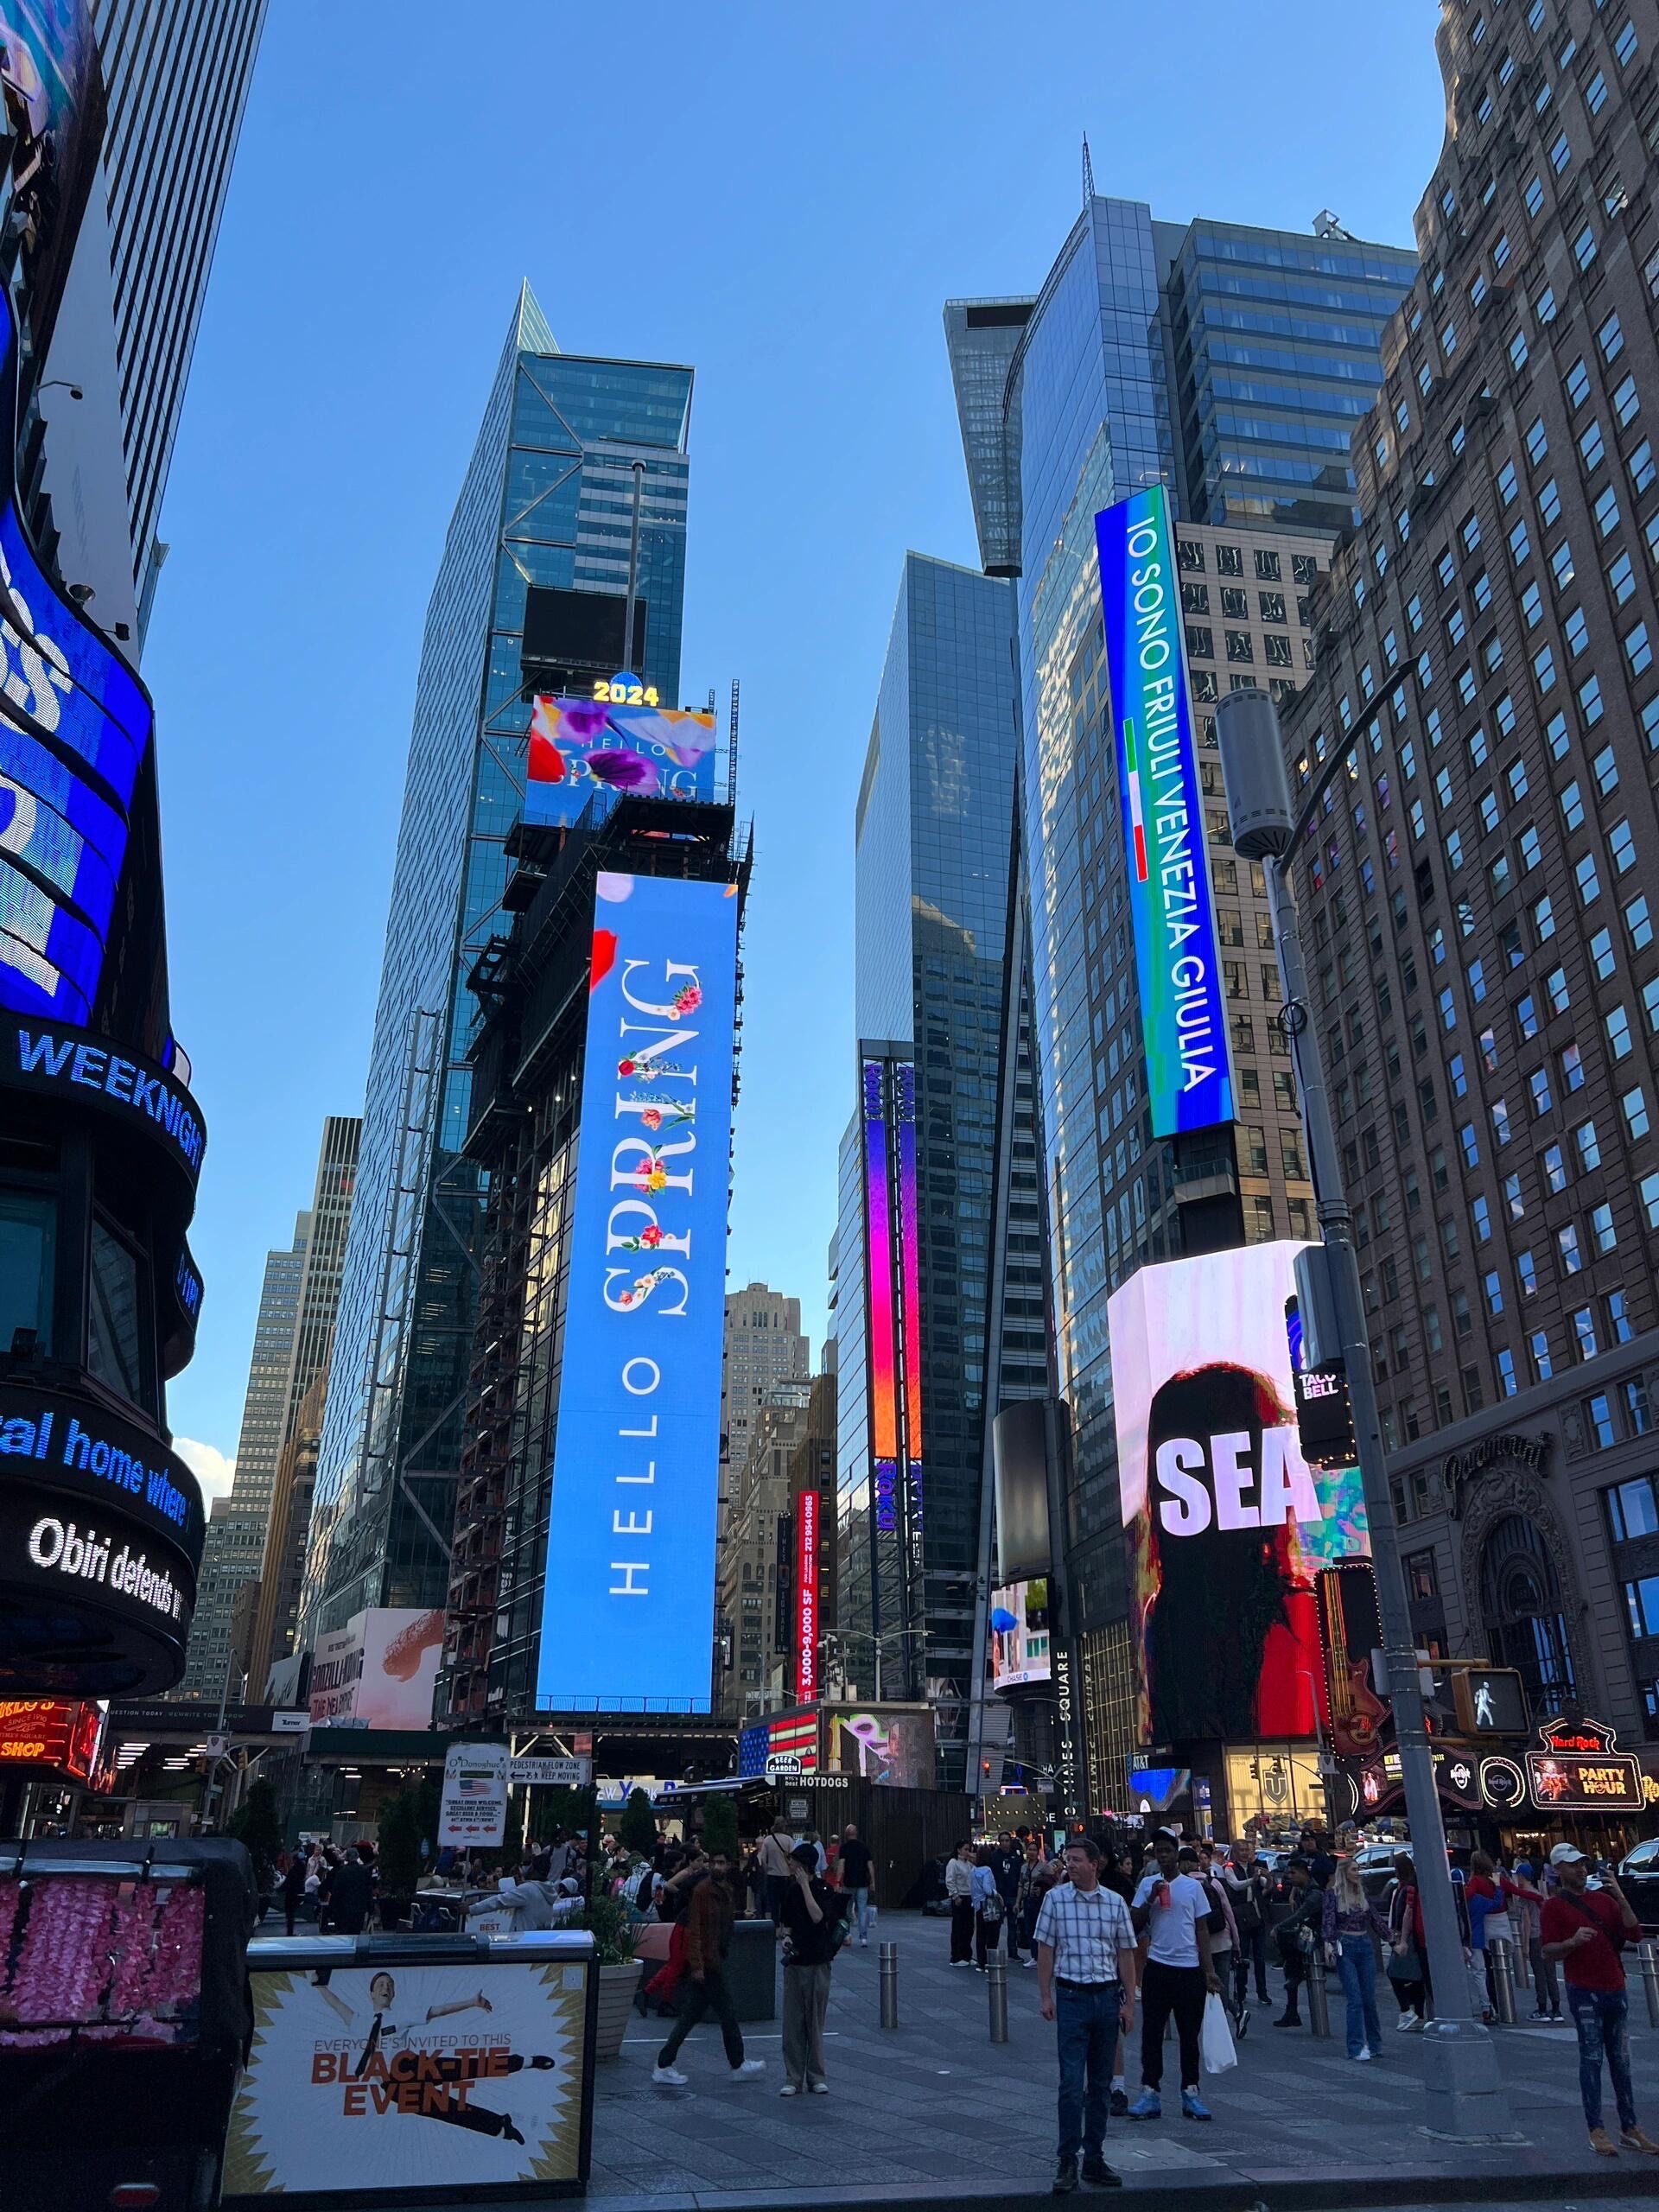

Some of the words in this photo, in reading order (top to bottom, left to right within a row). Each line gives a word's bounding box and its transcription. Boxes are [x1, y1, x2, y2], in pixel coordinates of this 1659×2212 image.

[1127, 517, 1158, 558] IO
[1131, 563, 1170, 671] SONO
[594, 681, 658, 706] 2024
[1143, 676, 1182, 780] FRIULI
[1154, 781, 1200, 950] VENEZIA
[1172, 956, 1217, 1092] GIULIA
[603, 958, 702, 1317] SPRING
[1303, 1382, 1339, 1400] BELL
[0, 1413, 54, 1459] al
[64, 1419, 143, 1493] home
[608, 1357, 660, 1595] HELLO
[1155, 1426, 1322, 1537] SEA
[29, 1518, 111, 1582] Obiri
[111, 1546, 173, 1613] defends
[803, 1589, 812, 1605] SF
[802, 1607, 813, 1686] 3,000-9,000
[1057, 1651, 1071, 1721] SQUARE
[9, 1715, 32, 1726] SINCE
[33, 1714, 48, 1723] 1910
[1, 1742, 45, 1757] SHOP
[1551, 1735, 1575, 1747] Hard
[1576, 1736, 1600, 1751] Rock
[510, 1760, 547, 1770] PEDESTRIAN
[548, 1761, 563, 1770] FLOW
[565, 1761, 581, 1770] ZONE
[557, 1771, 581, 1780] MOVING
[1133, 1755, 1149, 1770] AT&T
[1579, 1768, 1625, 1781] PARTY
[799, 1777, 849, 1788] HOTDOGS
[1582, 1781, 1627, 1795] HOUR
[315, 2037, 400, 2052] EVERYONE'S
[404, 2036, 458, 2048] INVITED
[461, 2034, 479, 2046] TO
[482, 2033, 512, 2045] THIS
[312, 2047, 510, 2084] BLACK-TIE
